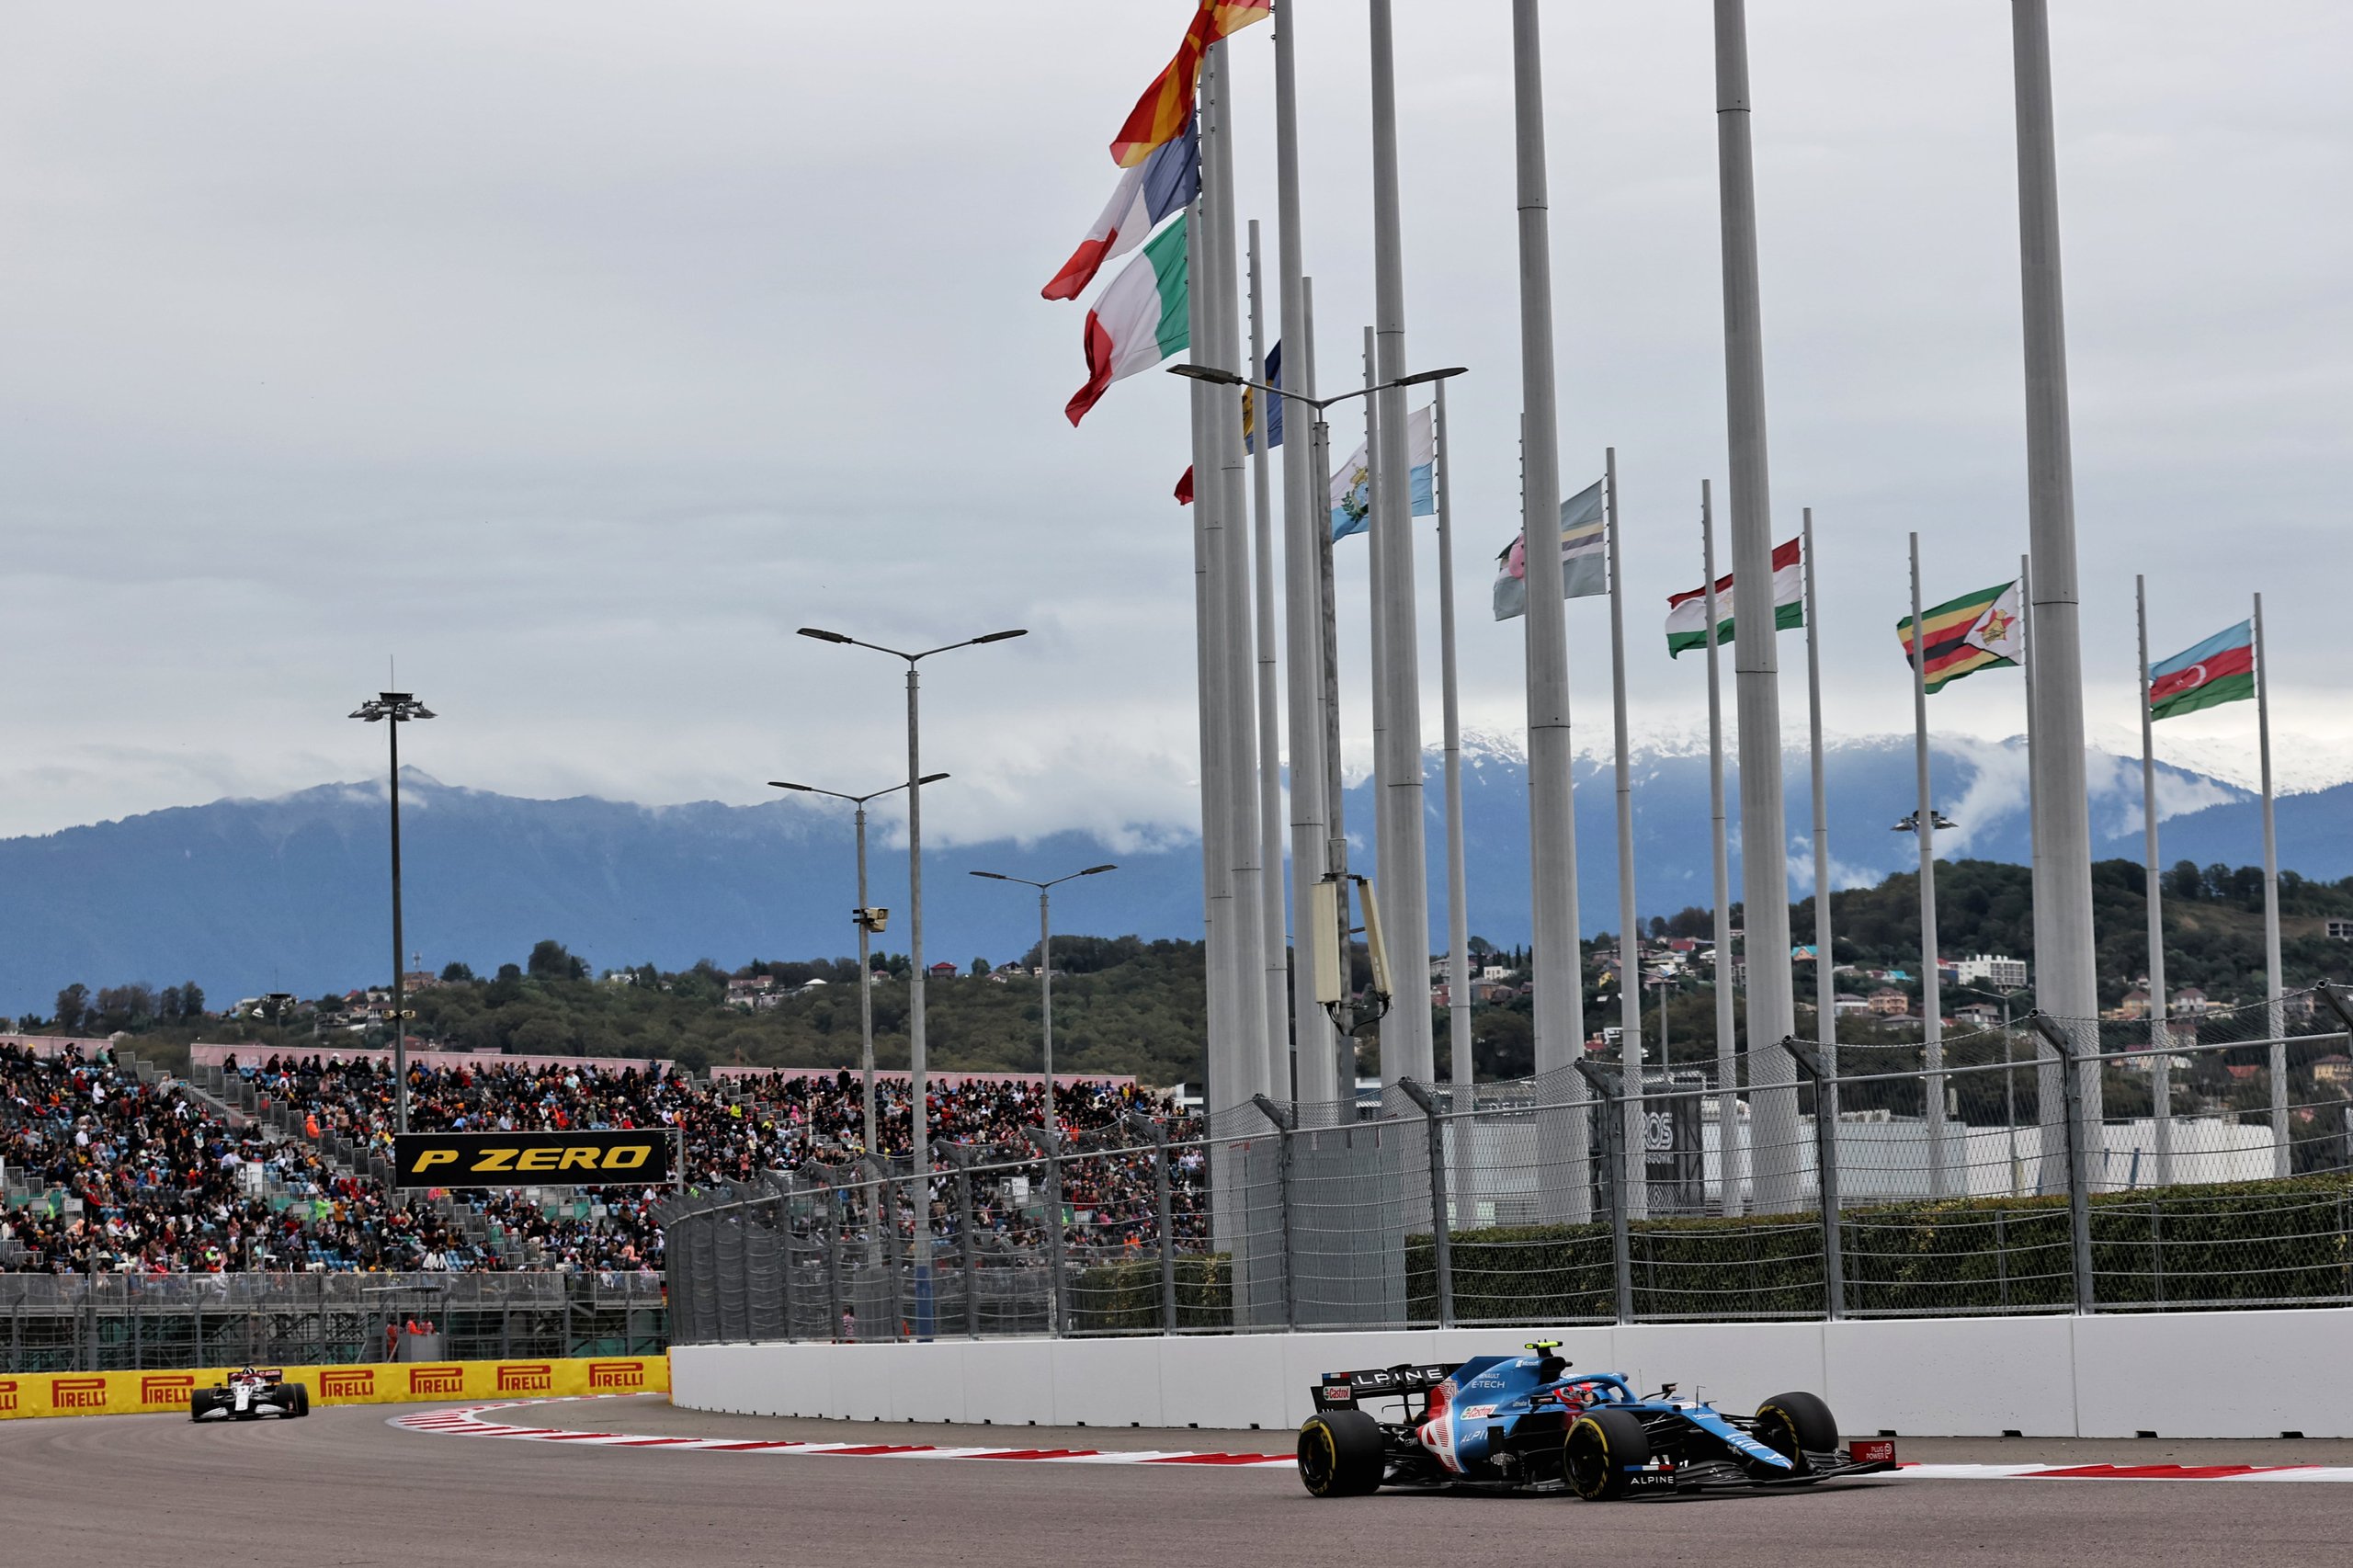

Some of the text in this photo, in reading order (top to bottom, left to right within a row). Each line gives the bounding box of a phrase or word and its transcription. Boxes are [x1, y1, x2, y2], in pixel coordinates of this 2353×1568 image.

[411, 1145, 653, 1173] P ZERO
[320, 1369, 374, 1398] PIRELLI
[409, 1367, 463, 1394] PIRELLI
[497, 1365, 551, 1391] PIRELLI
[589, 1362, 644, 1388] PIRELLI
[1351, 1369, 1445, 1386] LPINE
[51, 1378, 107, 1408] PIRELLI
[1329, 1387, 1350, 1399] Castrol
[1469, 1406, 1493, 1417] Castrol
[1460, 1429, 1506, 1444] ALPI
[1631, 1476, 1675, 1485] ALPINE
